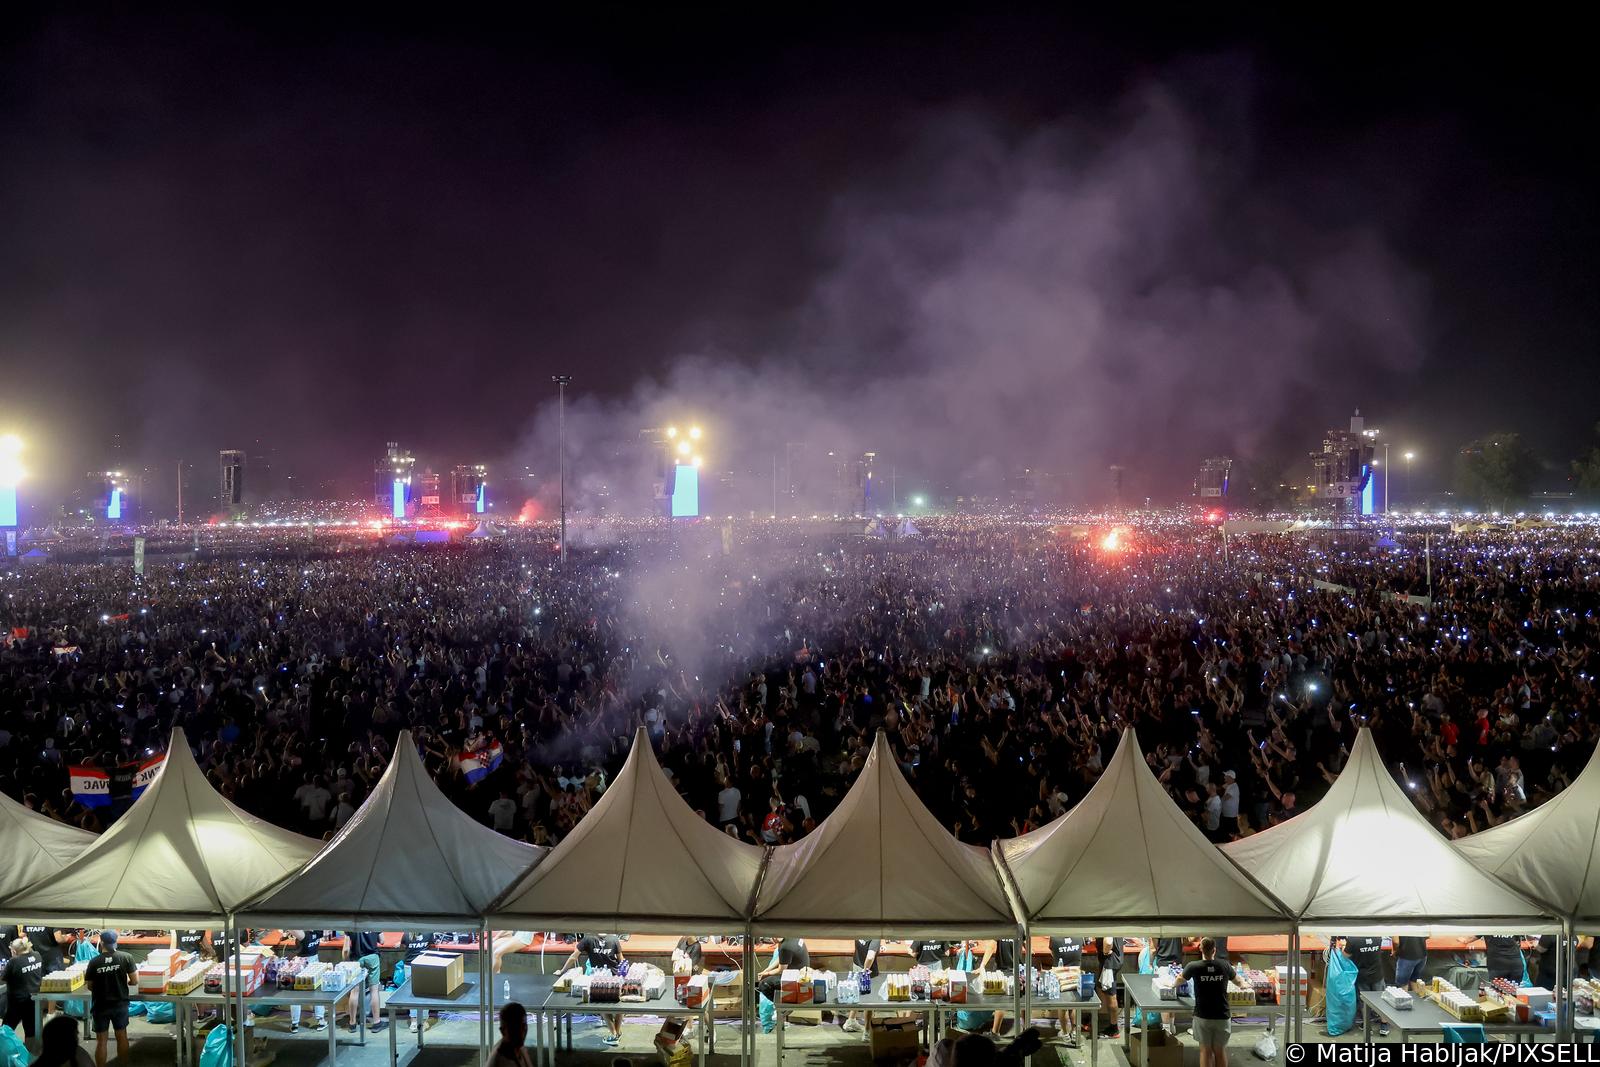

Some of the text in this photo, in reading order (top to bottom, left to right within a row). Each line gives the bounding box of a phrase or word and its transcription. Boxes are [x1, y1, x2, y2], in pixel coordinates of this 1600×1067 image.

[181, 935, 202, 943] STAFF
[408, 941, 429, 949] STAFF
[1058, 944, 1080, 953] STAFF
[1360, 945, 1380, 953] STAFF
[21, 961, 43, 974] STAFF
[96, 964, 121, 974] STAFF
